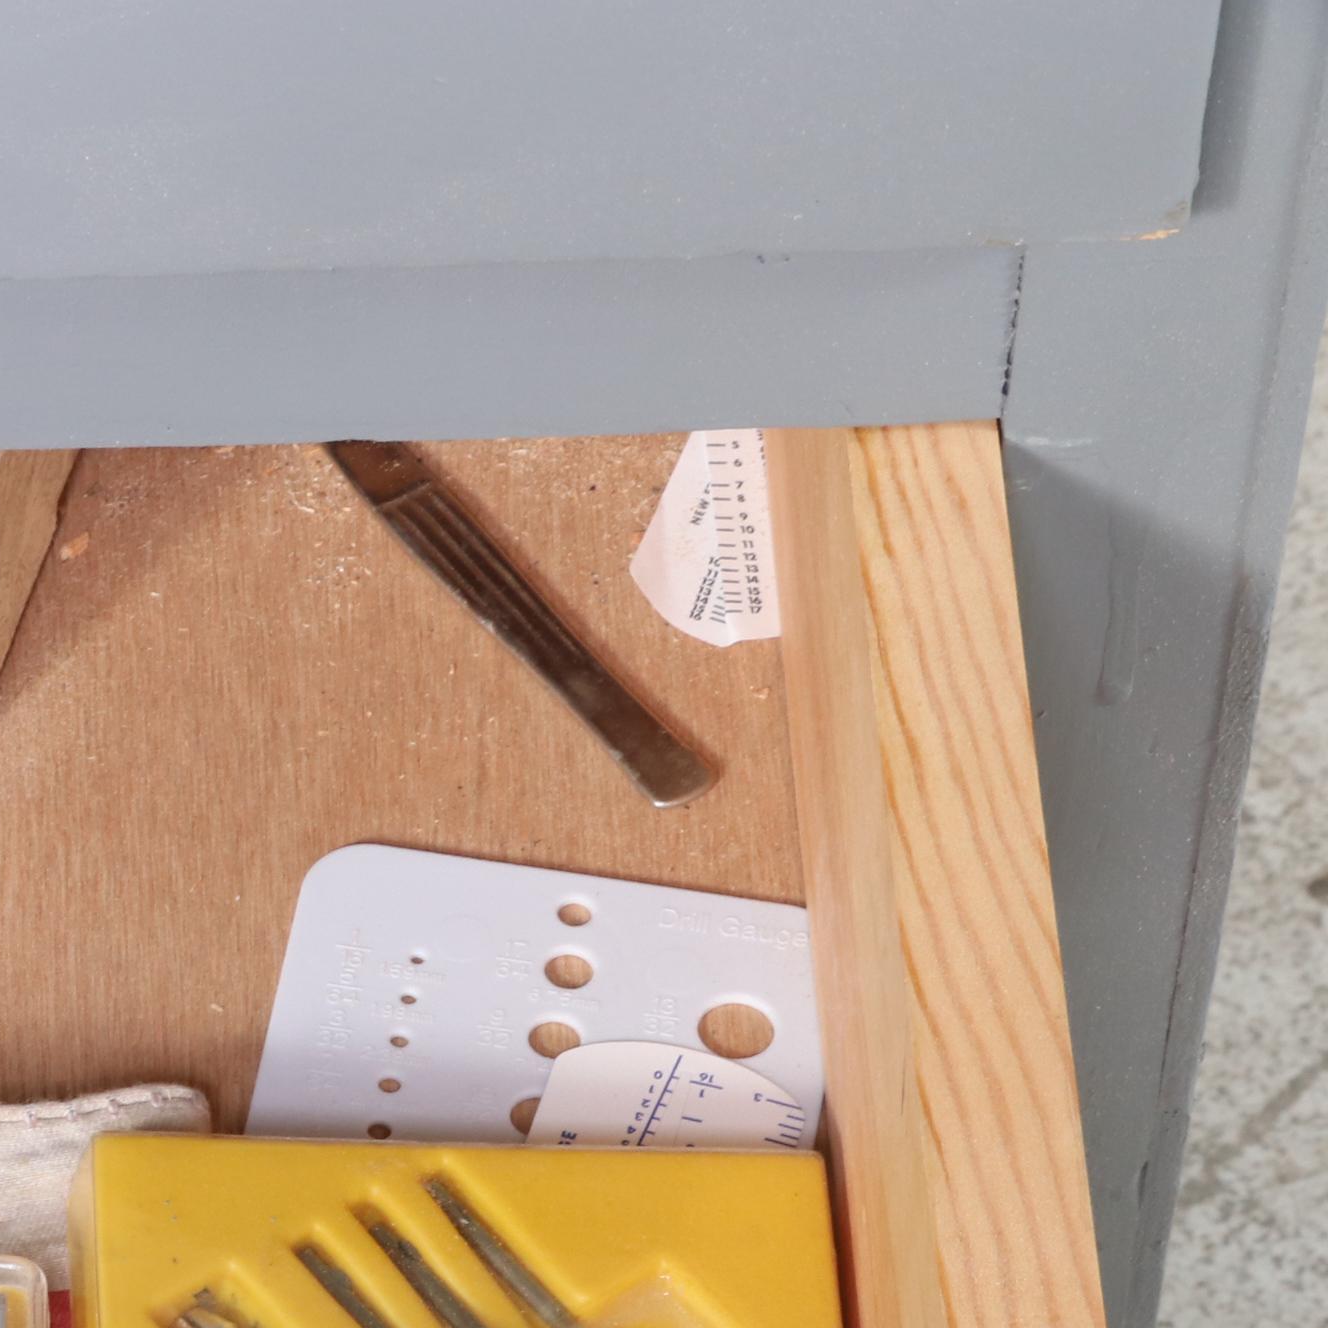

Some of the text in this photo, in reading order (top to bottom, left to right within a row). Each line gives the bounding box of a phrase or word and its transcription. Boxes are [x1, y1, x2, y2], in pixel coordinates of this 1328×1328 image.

[731, 440, 740, 450] 5
[733, 458, 743, 468] 6
[735, 480, 744, 490] 7
[737, 493, 746, 503] 8
[739, 511, 748, 521] 9
[740, 525, 755, 534] 10
[742, 540, 755, 549] 11
[743, 552, 757, 561] 12
[745, 564, 759, 573] 13
[746, 575, 759, 584] 14
[747, 586, 761, 595] 15
[748, 596, 762, 605] 16
[750, 605, 762, 614] 17
[658, 907, 808, 950] Drill Gauge
